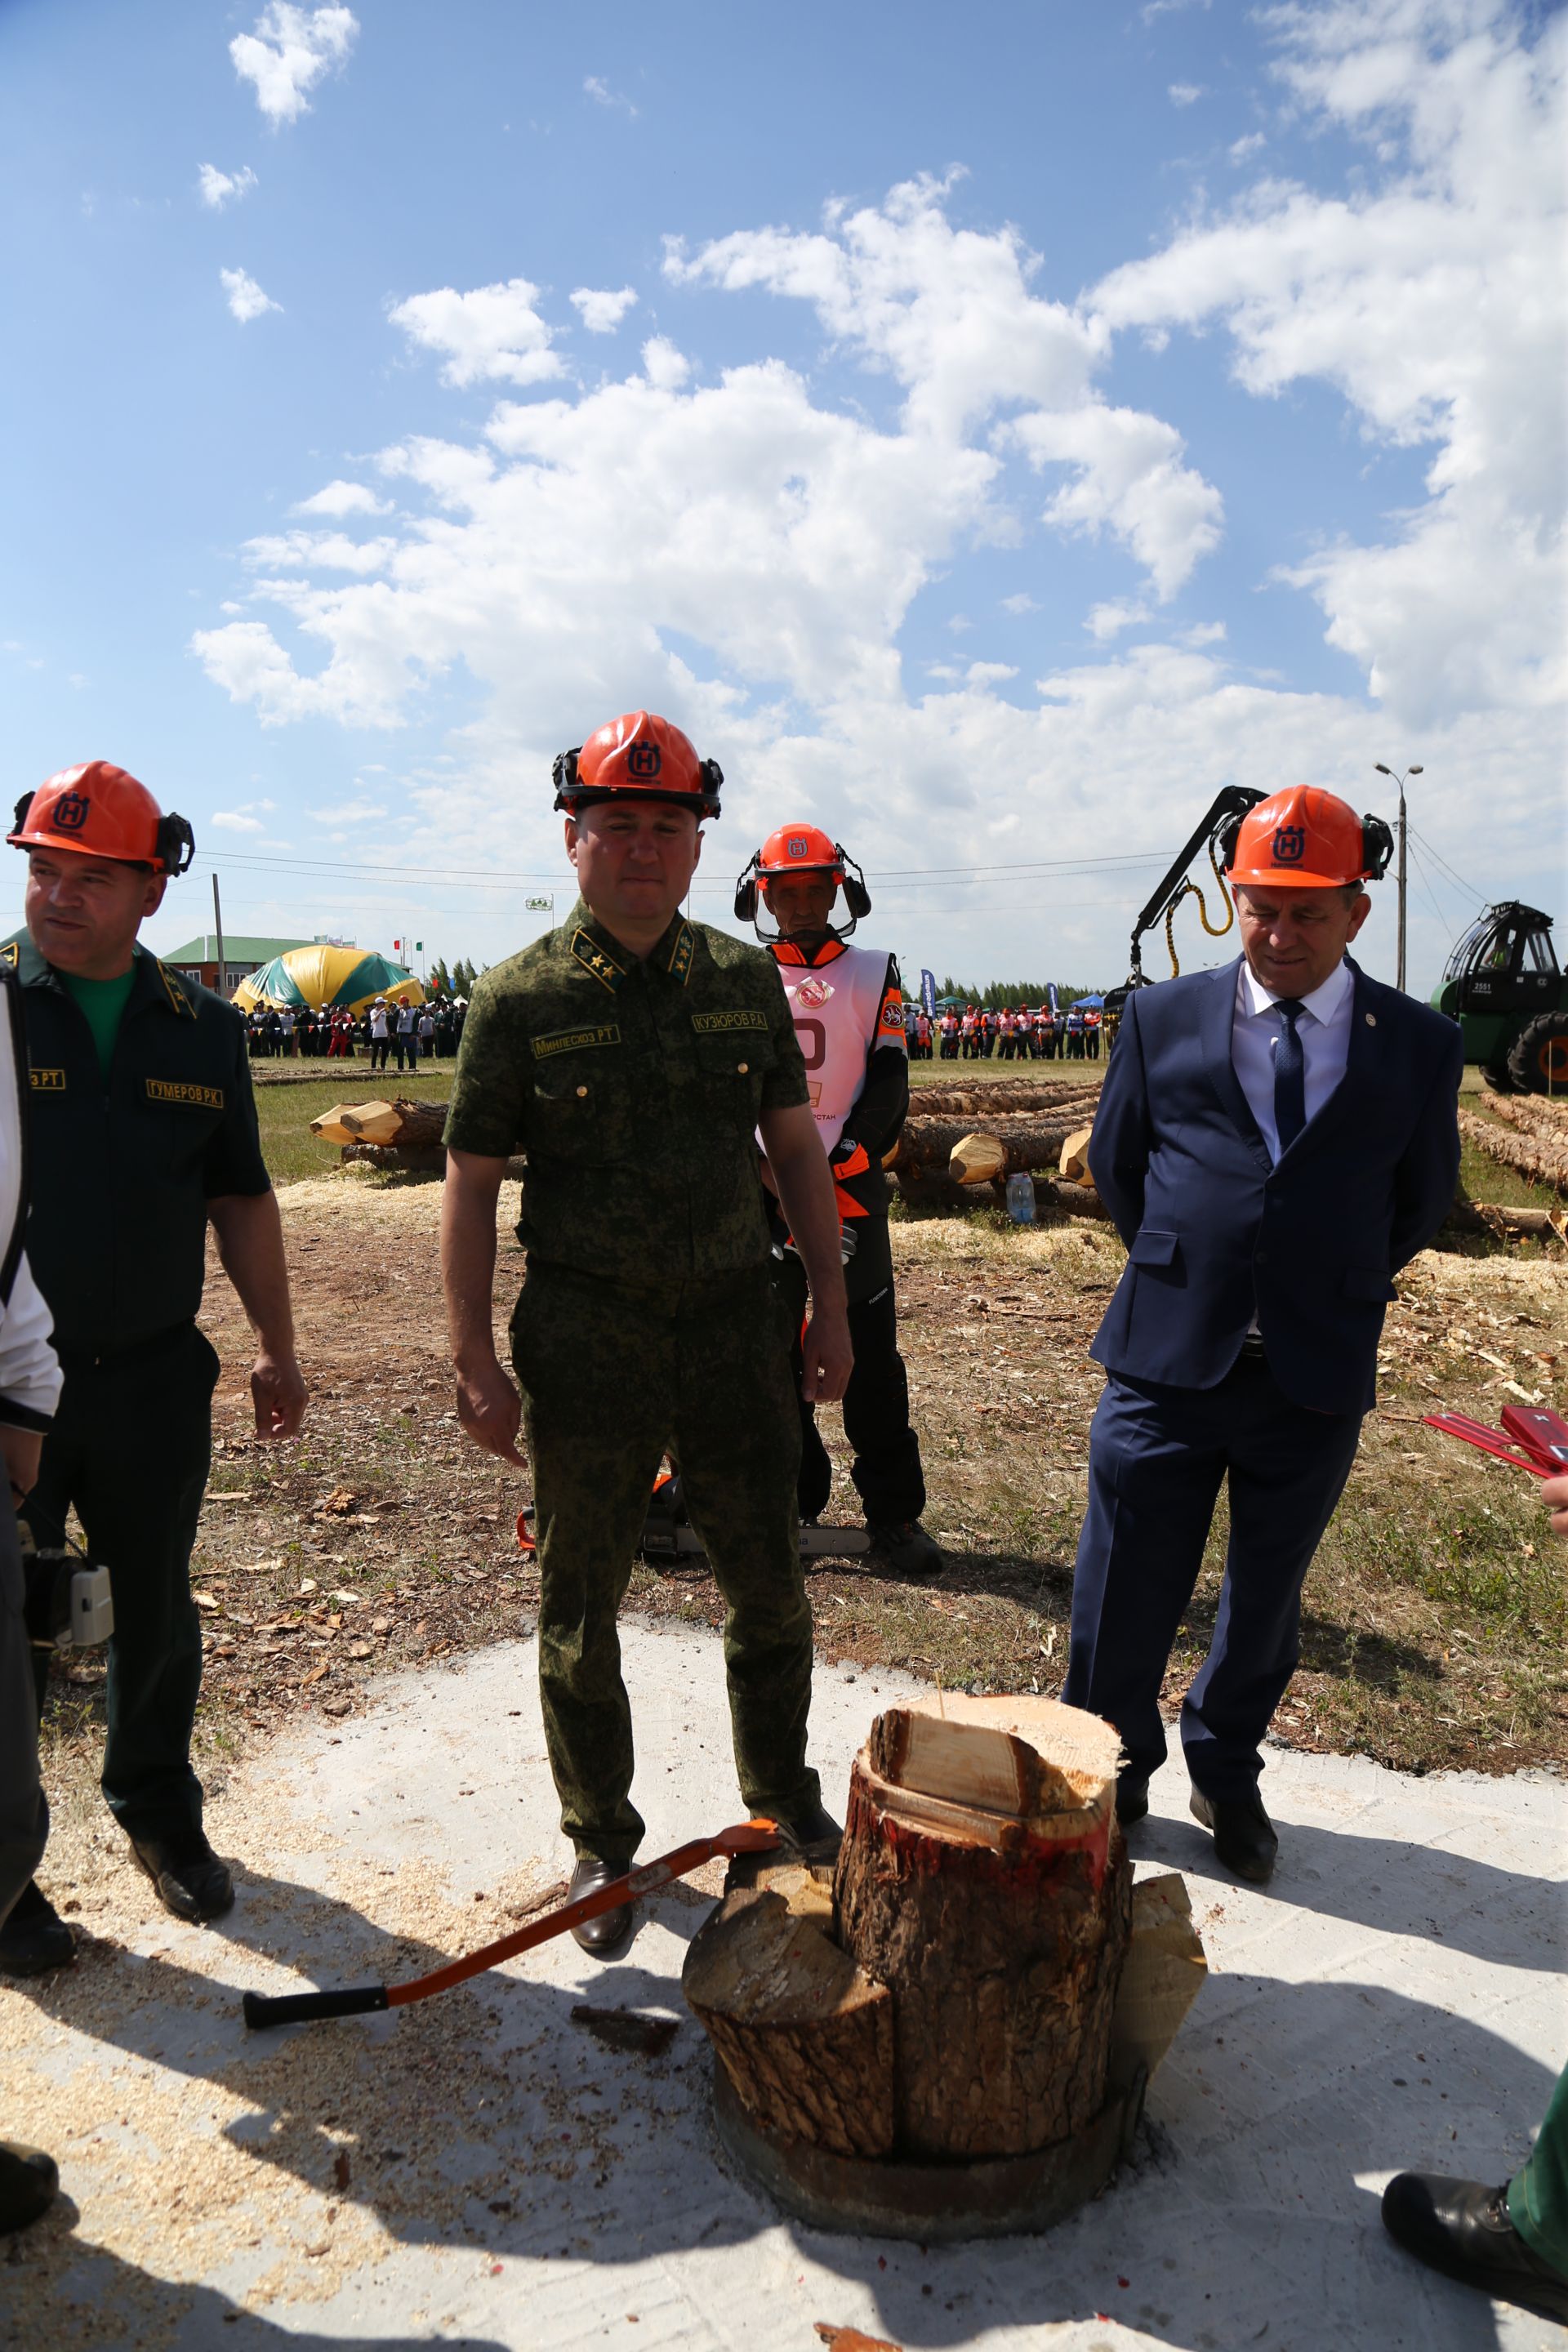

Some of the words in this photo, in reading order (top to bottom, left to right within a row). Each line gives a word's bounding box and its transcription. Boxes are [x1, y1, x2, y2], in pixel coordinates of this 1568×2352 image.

[1474, 982, 1490, 991] 2551
[696, 1013, 749, 1029] КУЗЮРОВ
[599, 1028, 612, 1041] РТ
[42, 1072, 58, 1086] РТ
[150, 1082, 202, 1102] ГУМЕРОВ
